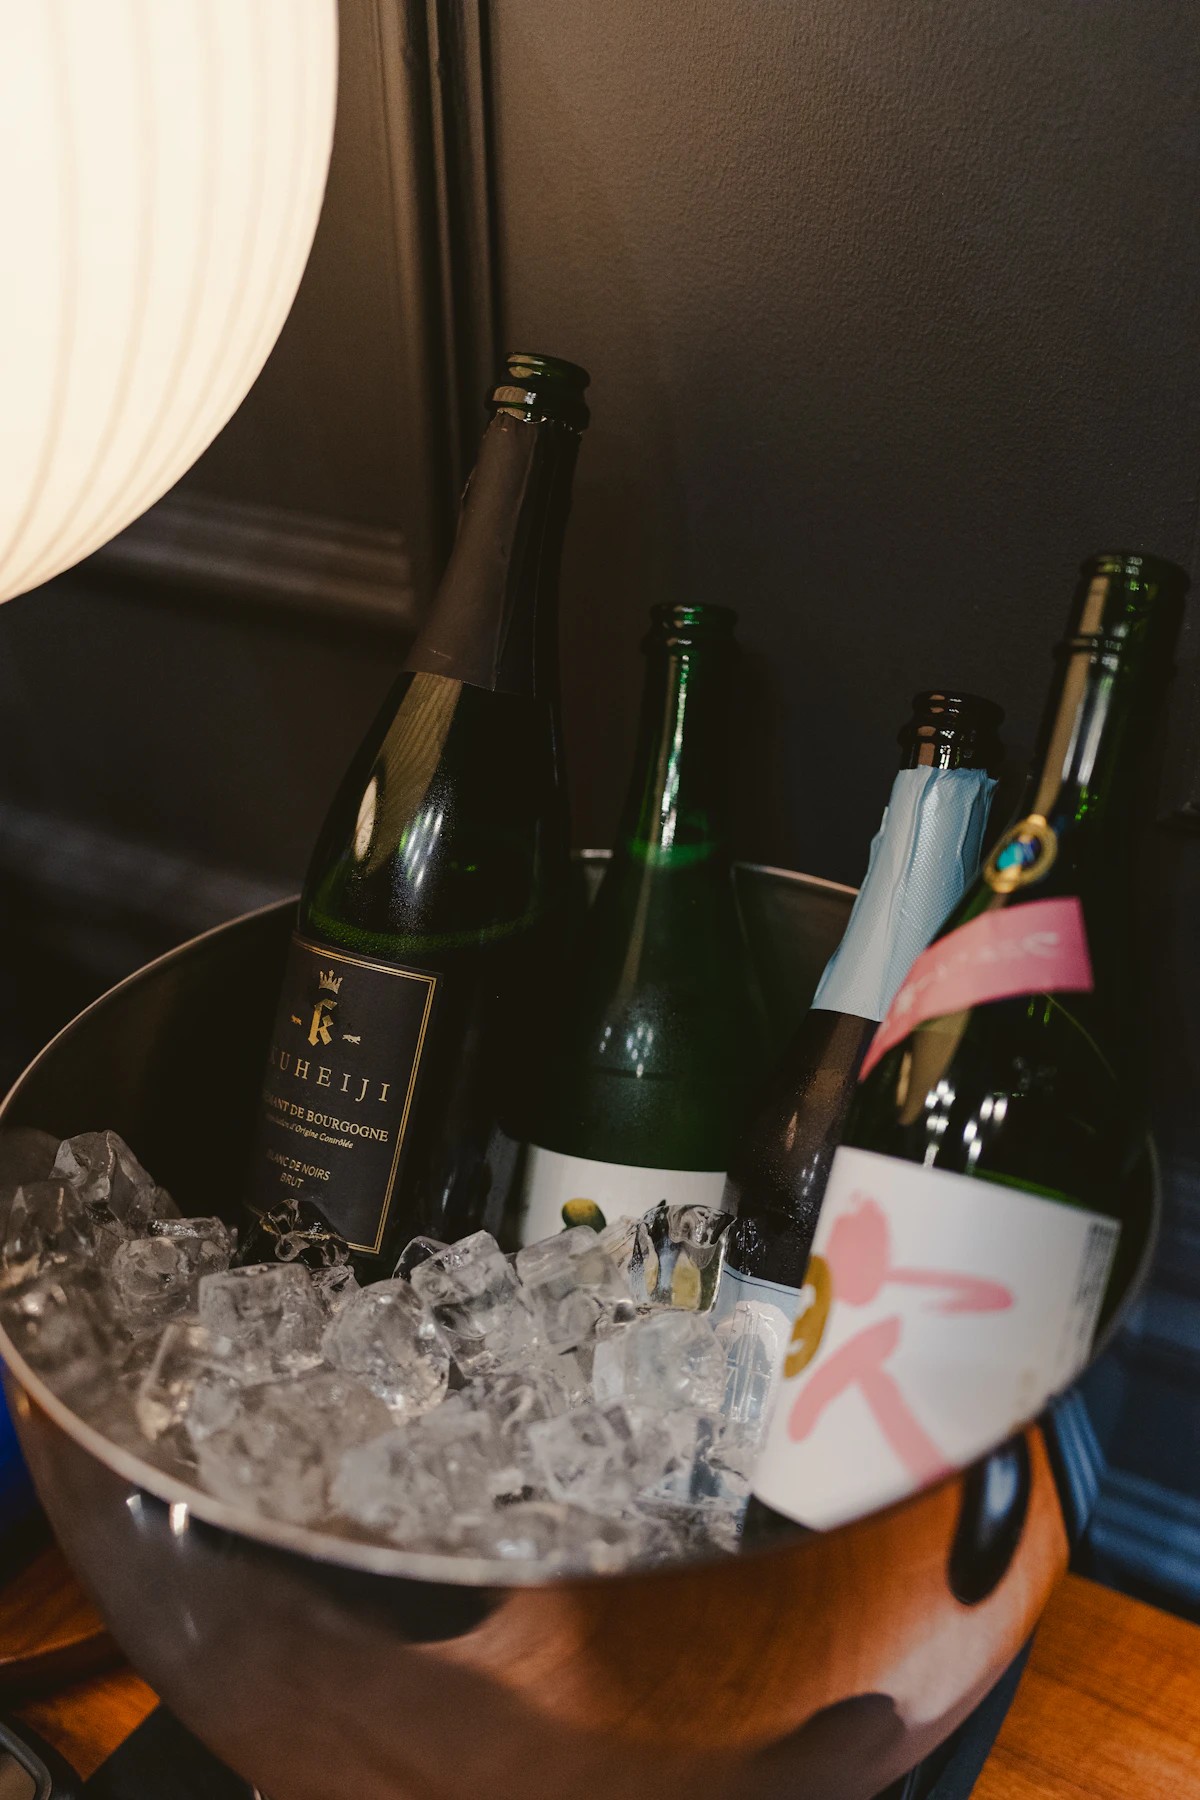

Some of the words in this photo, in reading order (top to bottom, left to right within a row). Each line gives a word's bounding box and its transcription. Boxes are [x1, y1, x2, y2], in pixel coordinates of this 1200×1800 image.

[290, 1104, 305, 1119] DE
[306, 1109, 389, 1142] BOURGOGNE
[319, 1132, 354, 1149] Contrôlée
[288, 1158, 303, 1172] DE
[301, 1163, 331, 1182] NOIRS
[280, 1172, 305, 1189] BRUT
